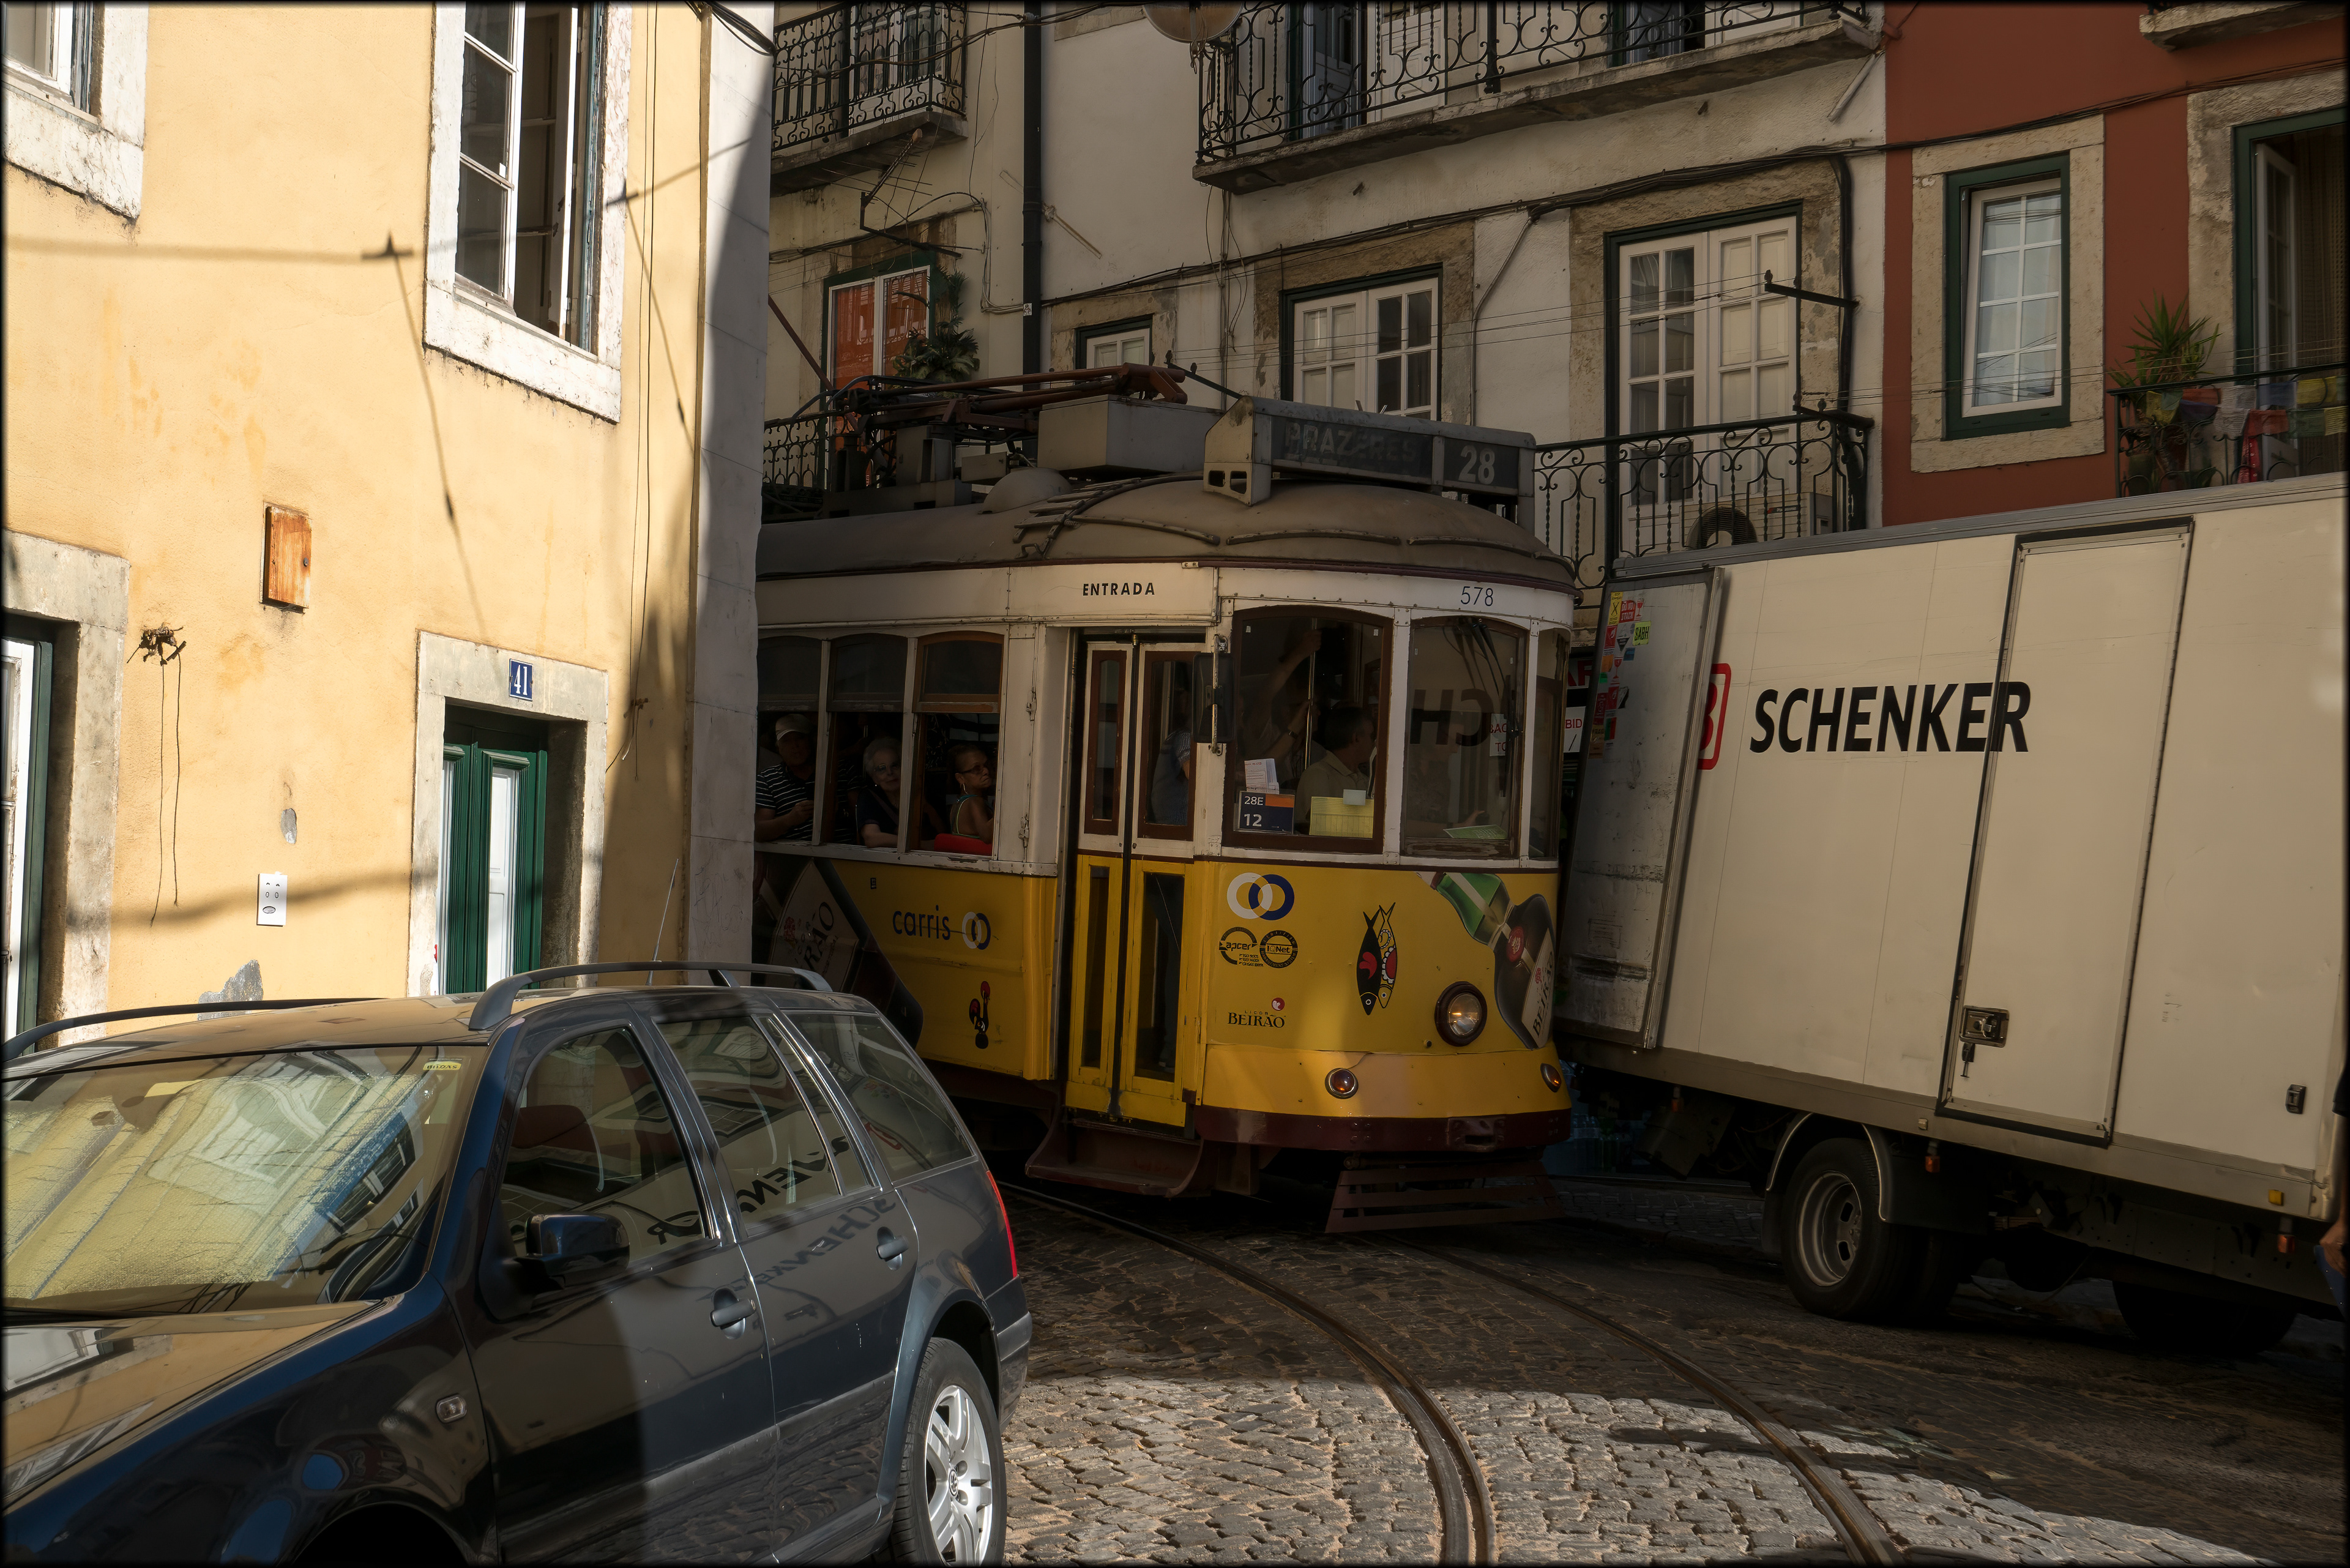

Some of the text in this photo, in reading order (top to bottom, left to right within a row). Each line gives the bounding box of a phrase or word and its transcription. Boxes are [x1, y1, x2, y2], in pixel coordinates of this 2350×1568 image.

[1458, 444, 1496, 485] 28
[1083, 582, 1155, 596] ENTRADA
[1460, 586, 1493, 607] 578
[514, 665, 528, 695] 41
[1750, 681, 2031, 753] SCHENKER
[1244, 796, 1264, 805] 28E
[1244, 813, 1262, 827] 12
[893, 905, 950, 940] carris
[1226, 942, 1251, 951] apcer
[1228, 1012, 1285, 1028] BEIRÃO
